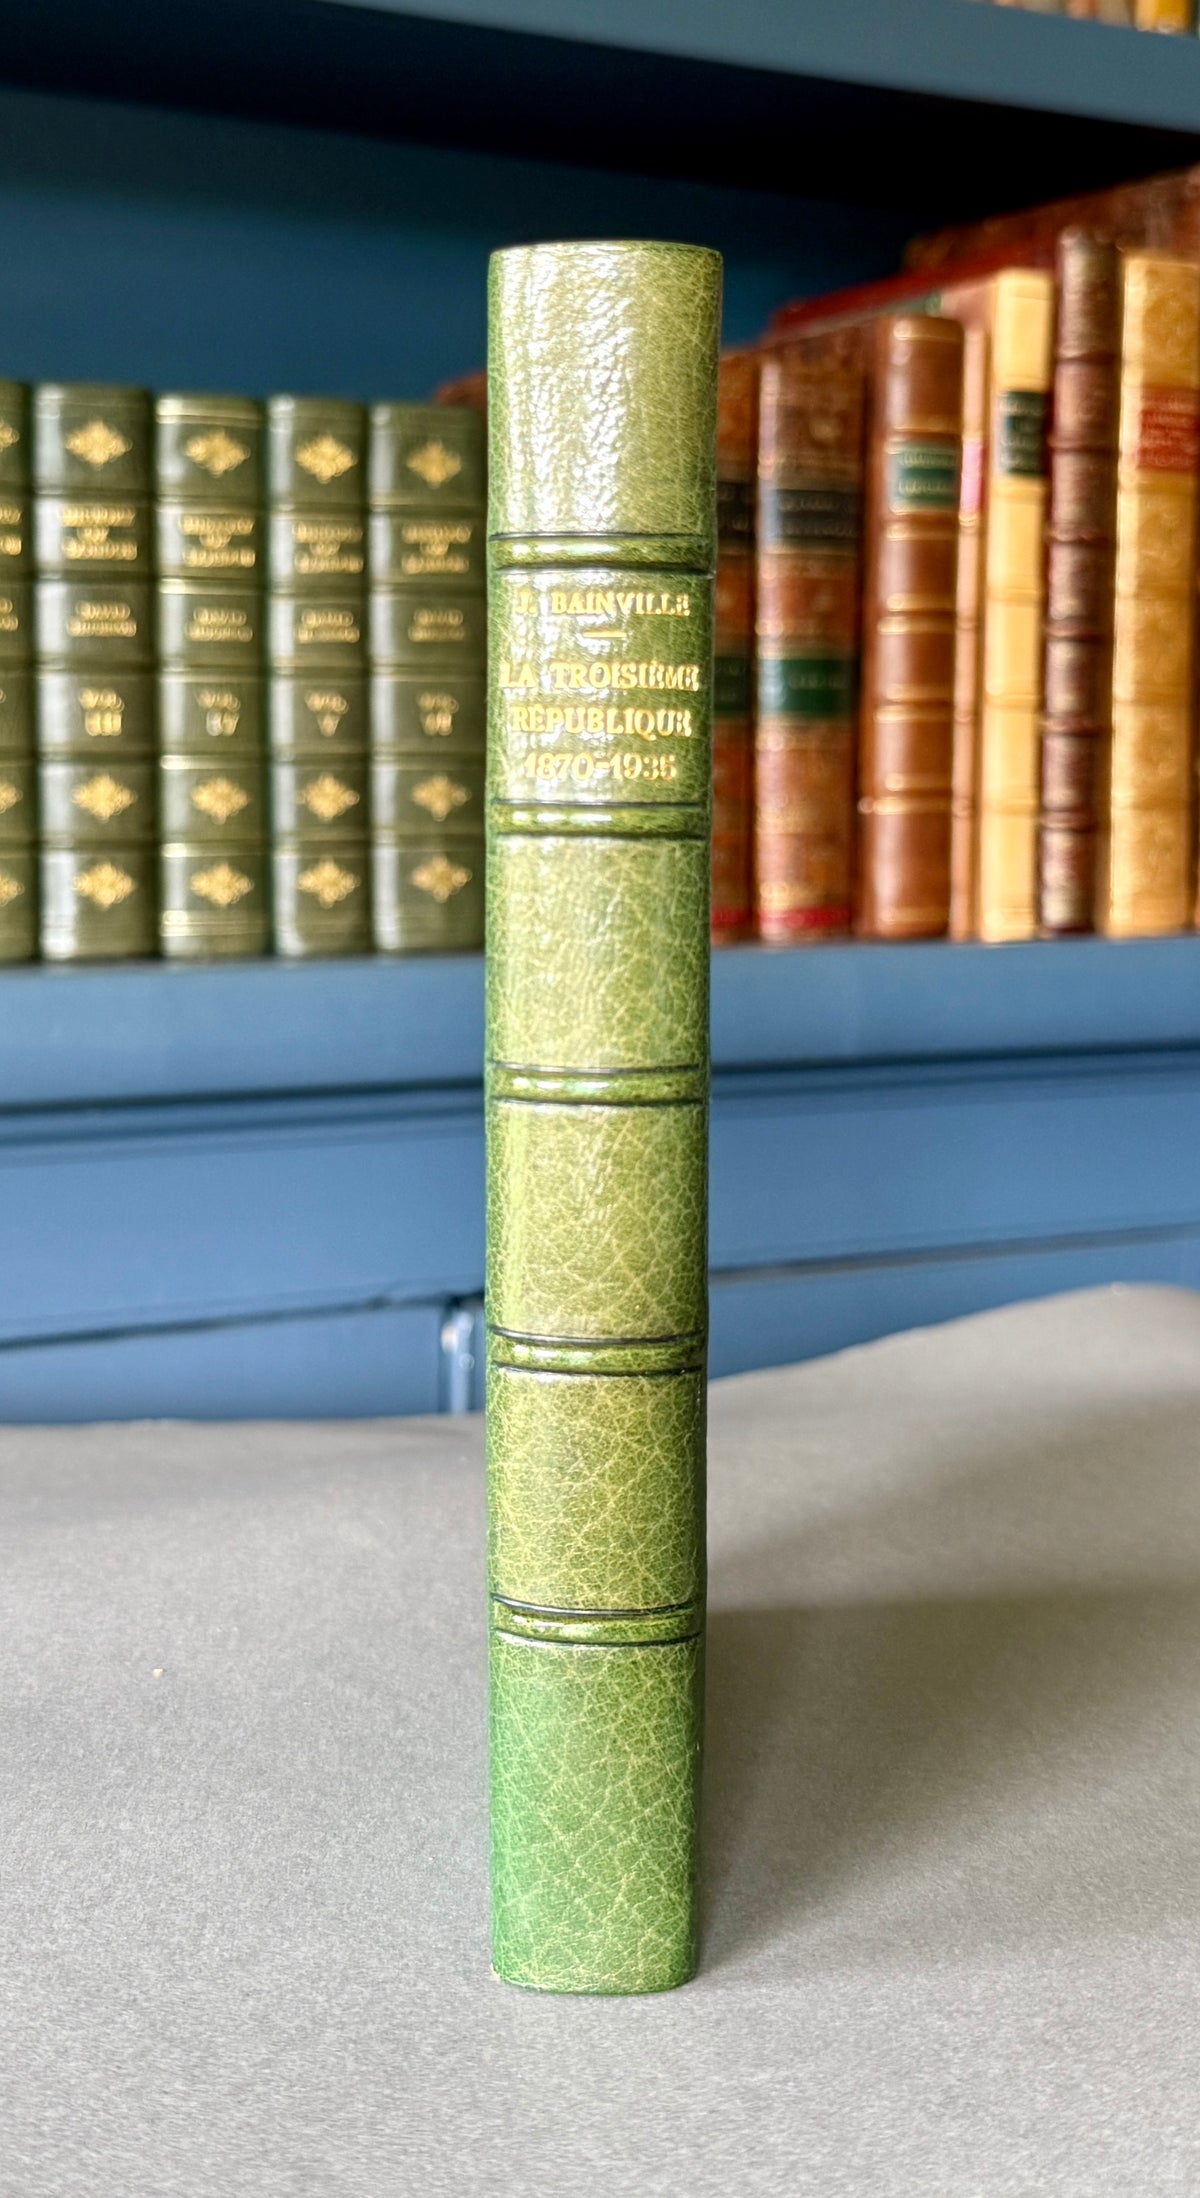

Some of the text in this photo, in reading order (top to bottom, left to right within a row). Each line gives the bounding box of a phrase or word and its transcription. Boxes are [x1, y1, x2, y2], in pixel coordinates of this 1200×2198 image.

[517, 590, 690, 616] J. BAINVILLE
[499, 661, 537, 688] LA
[525, 752, 677, 781] 1870-1935
